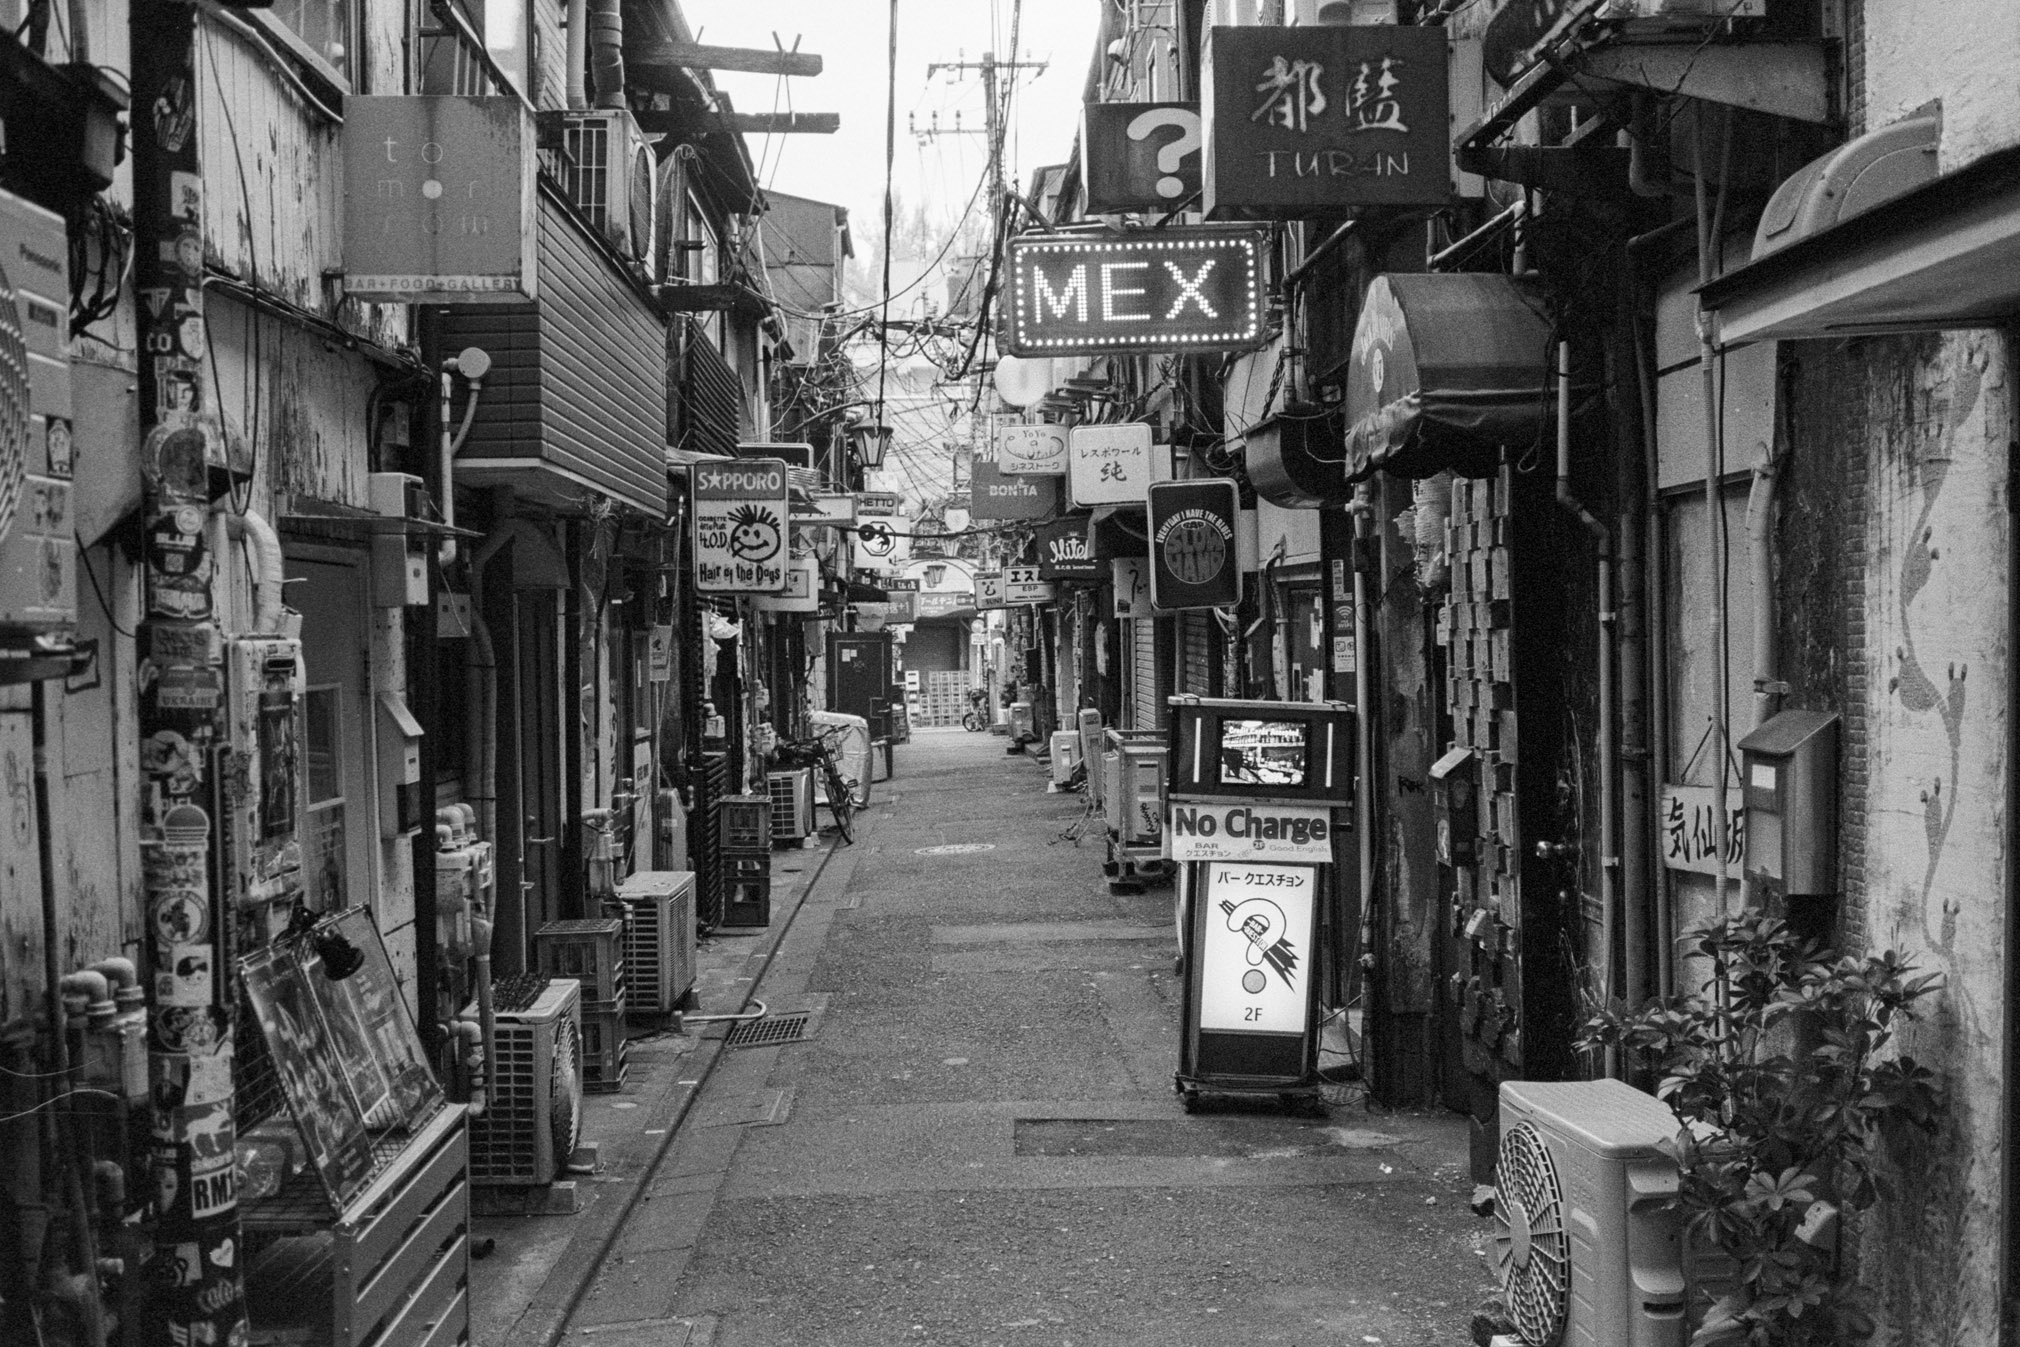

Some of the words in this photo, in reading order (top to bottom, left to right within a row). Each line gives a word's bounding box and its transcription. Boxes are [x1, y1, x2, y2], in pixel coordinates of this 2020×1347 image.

[1255, 150, 1409, 177] TURAN
[1033, 259, 1218, 323] MEX
[1080, 446, 1142, 459] レスポワール
[1100, 460, 1128, 482] 純
[858, 497, 895, 507] HETTO
[1185, 508, 1204, 519] HAVE
[1204, 510, 1218, 523] THE
[1215, 518, 1233, 540] BLUES
[700, 562, 721, 583] Hair
[736, 562, 753, 582] the
[756, 563, 780, 585] Dogs
[1175, 807, 1217, 837] No
[1225, 808, 1327, 845] Charge
[1186, 850, 1231, 858] クエスチョン
[1297, 845, 1327, 853] English
[1218, 871, 1240, 884] バー
[1245, 873, 1304, 887] クエスチョン
[1244, 1007, 1263, 1021] 2F
